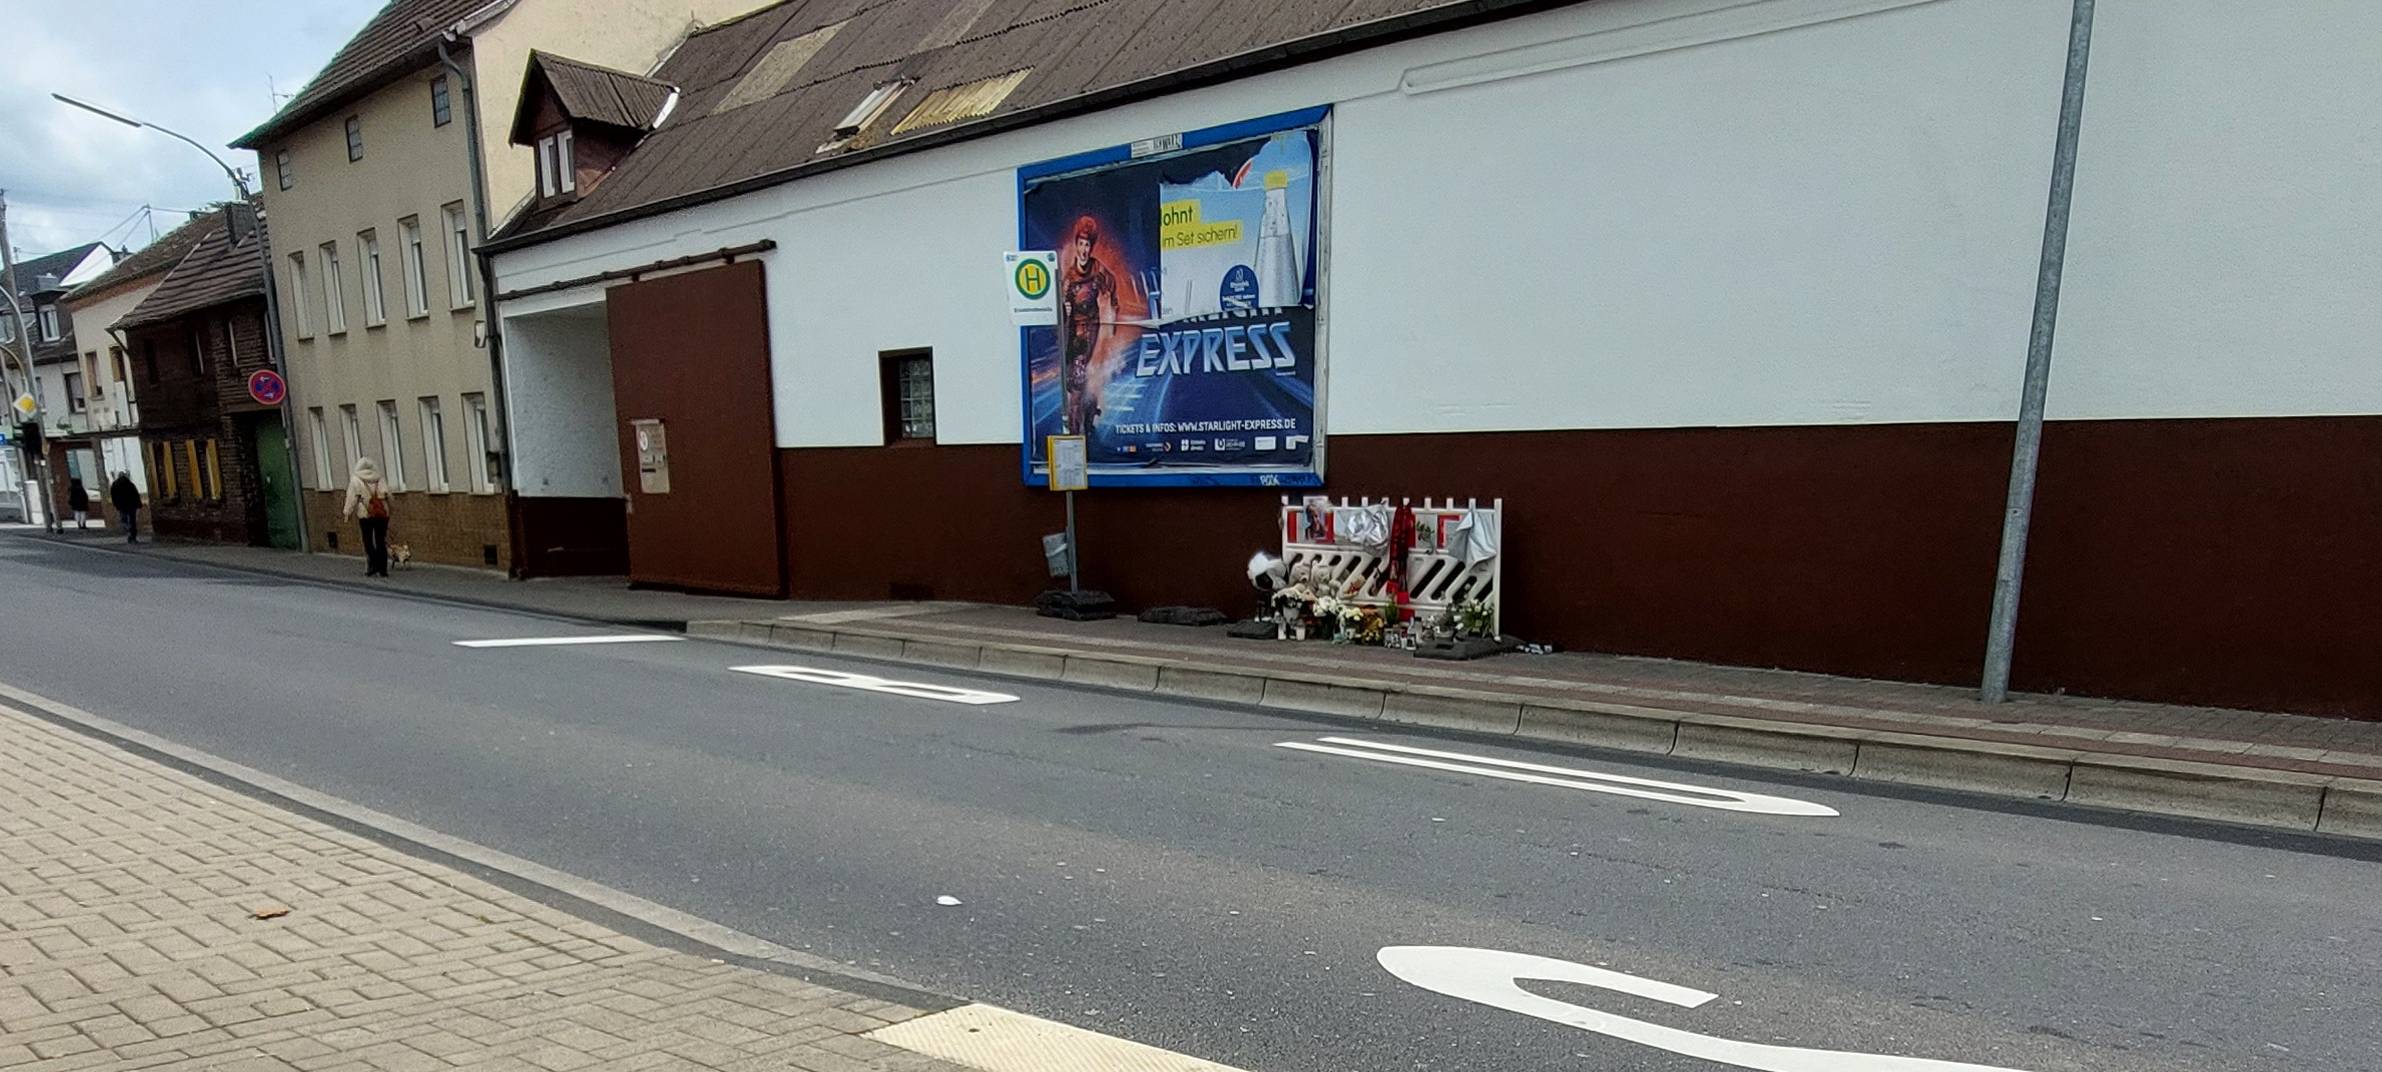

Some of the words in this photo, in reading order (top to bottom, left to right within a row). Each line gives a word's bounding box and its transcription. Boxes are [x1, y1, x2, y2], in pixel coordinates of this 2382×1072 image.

[1177, 232, 1194, 247] Set
[1197, 224, 1238, 244] sichern!
[1024, 268, 1041, 291] H
[1136, 321, 1296, 377] EXPRESS
[1116, 423, 1145, 434] TICKETS
[1146, 423, 1151, 433] &
[1152, 422, 1177, 433] INFOS:
[1178, 418, 1296, 432] WWW.STARLIGHT-EXPRESS.DE
